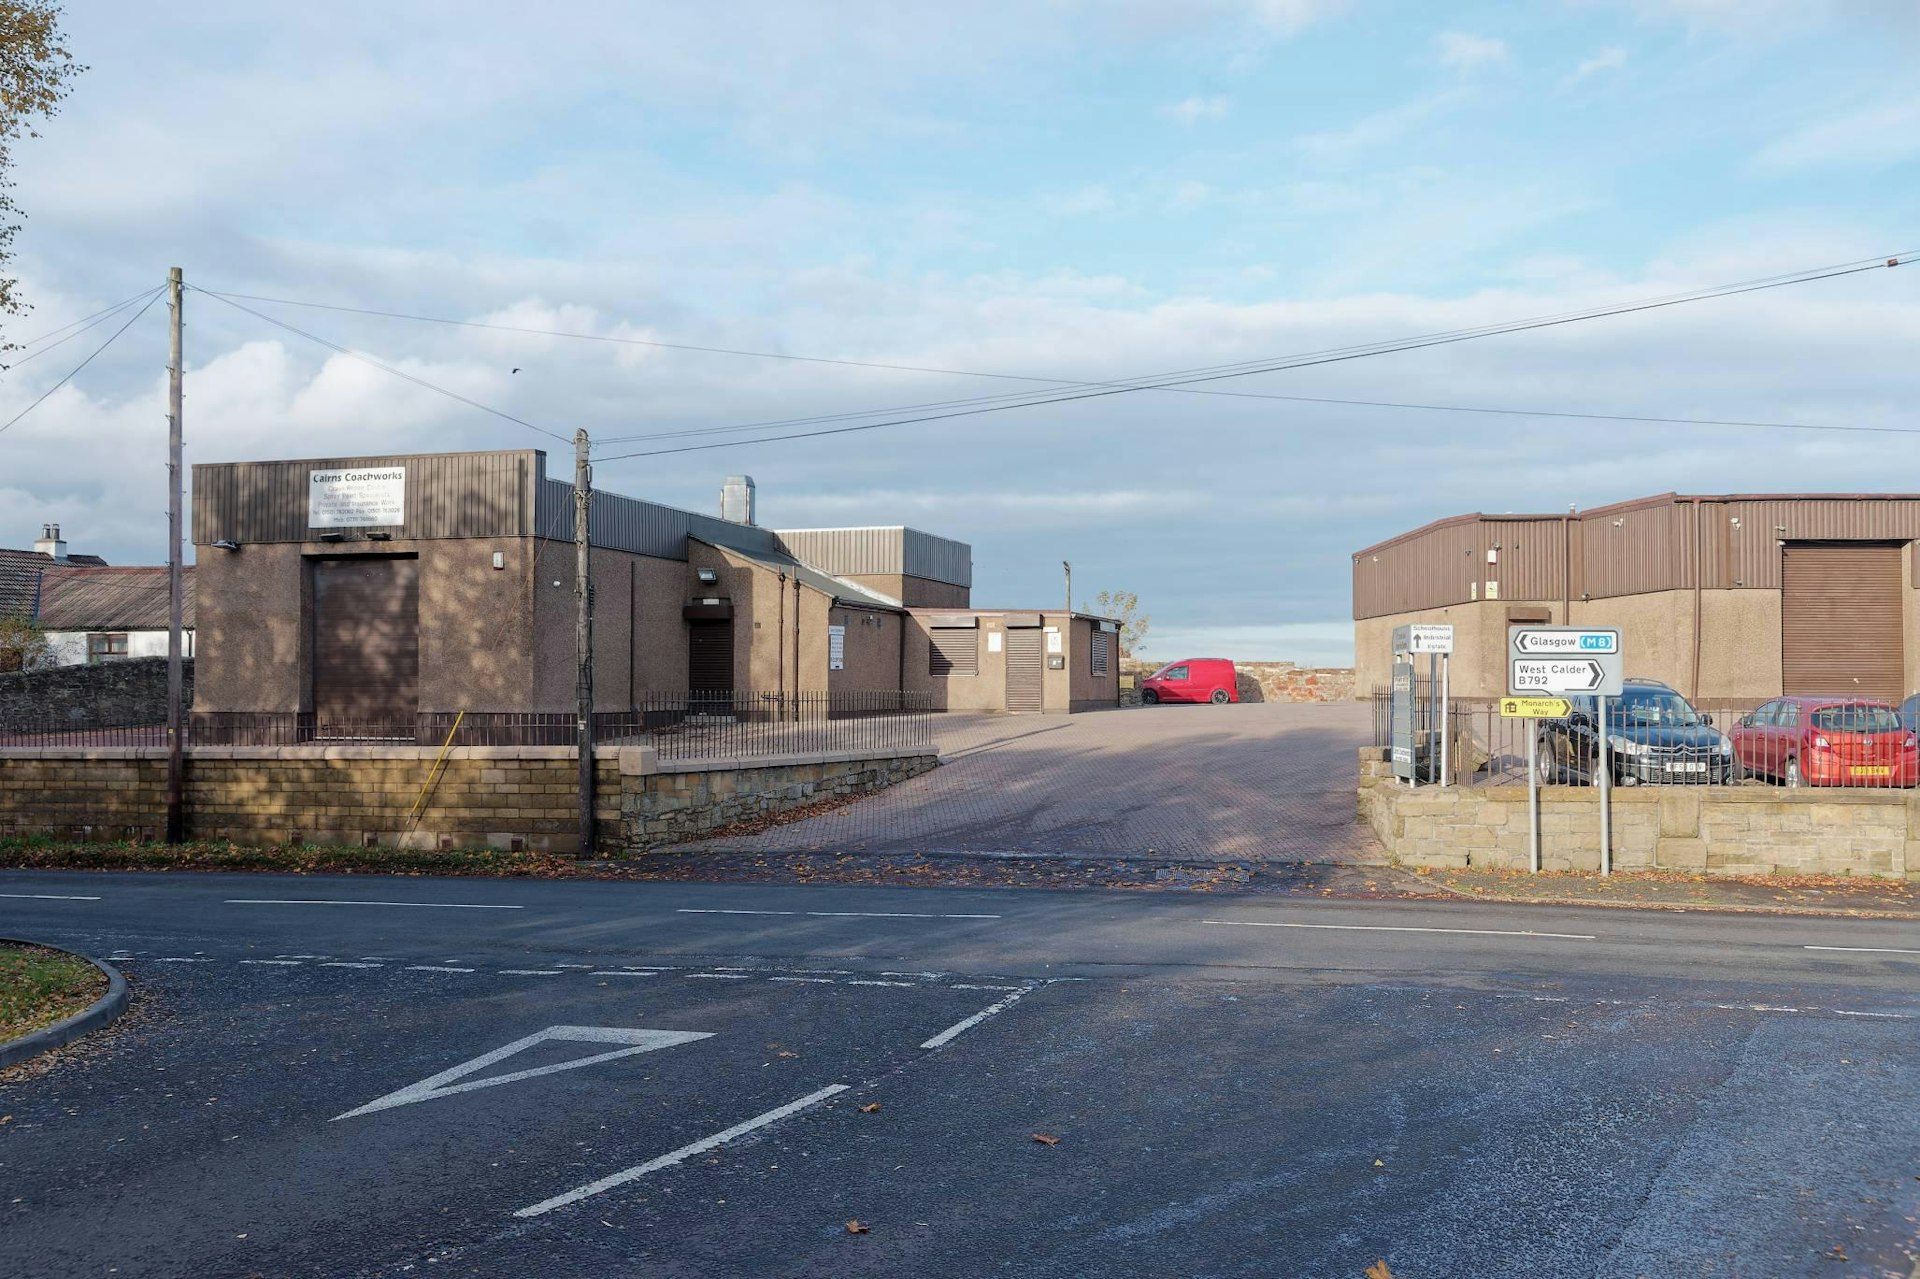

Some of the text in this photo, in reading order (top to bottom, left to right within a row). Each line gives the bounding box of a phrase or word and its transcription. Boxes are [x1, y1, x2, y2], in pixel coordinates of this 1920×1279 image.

[313, 472, 403, 483] Cairns Coachworks
[1530, 636, 1576, 647] Glasgow
[1519, 665, 1587, 674] West Calder
[1519, 676, 1548, 685] B792
[1533, 708, 1548, 716] Way
